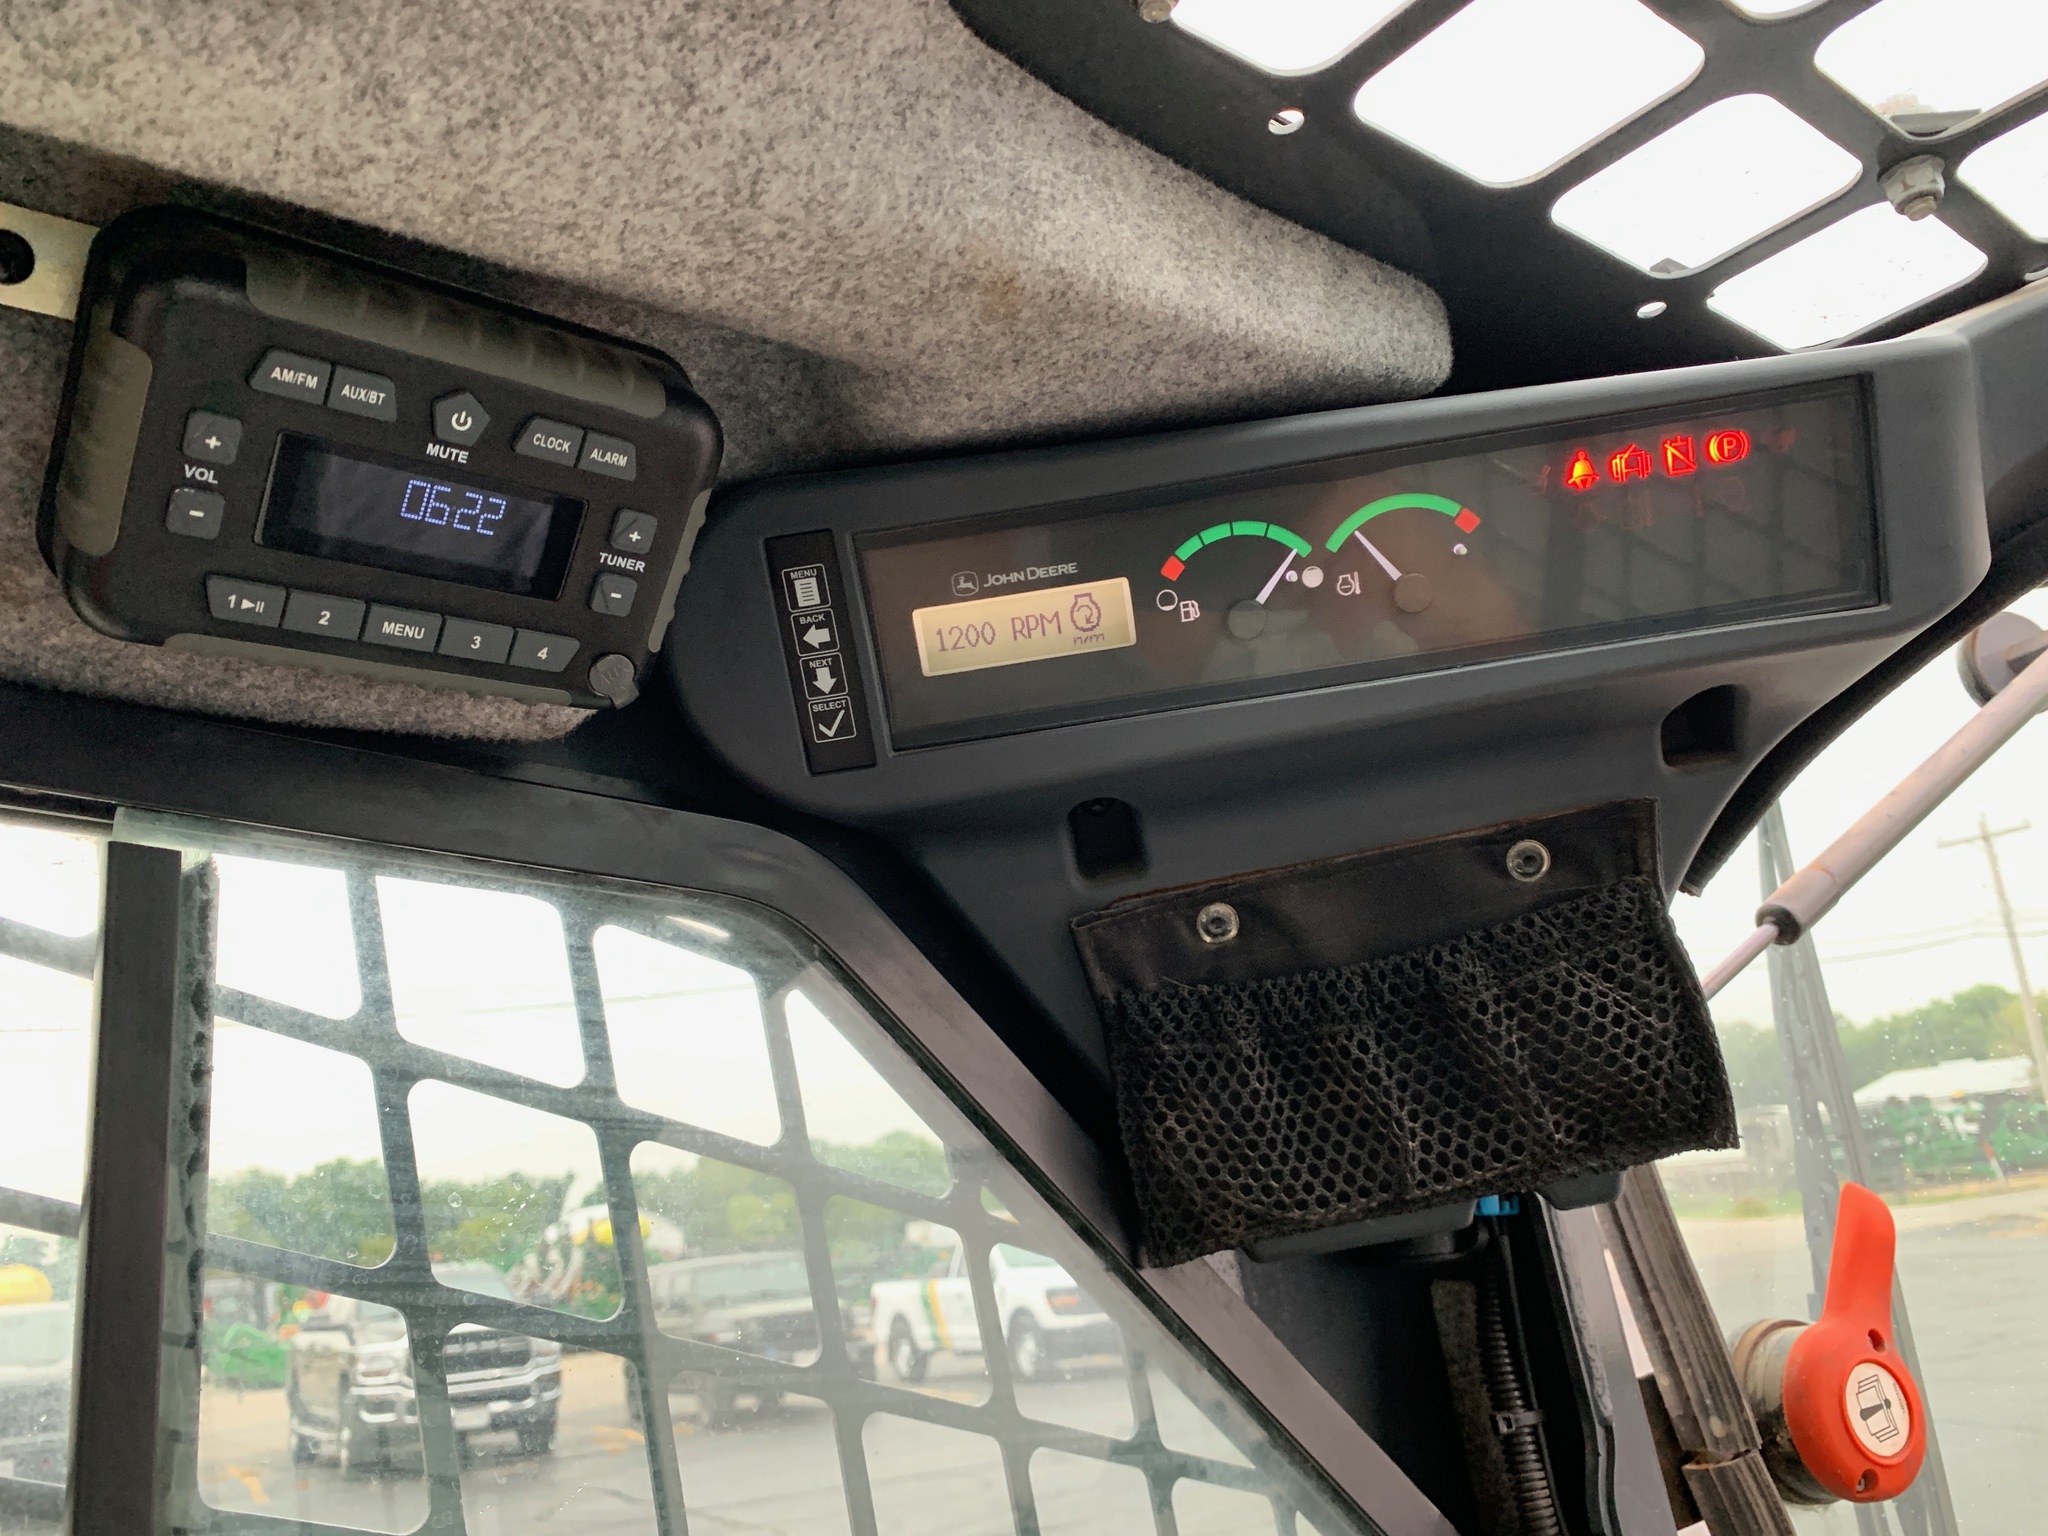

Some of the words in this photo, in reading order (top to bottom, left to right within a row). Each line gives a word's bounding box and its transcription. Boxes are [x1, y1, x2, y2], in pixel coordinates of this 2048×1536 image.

[271, 366, 318, 390] AM/FM
[341, 383, 386, 406] AUX/BT
[426, 442, 469, 464] MUTE
[533, 433, 572, 453] CLOCK
[589, 447, 628, 467] ALARM
[183, 464, 219, 484] VOL
[599, 552, 646, 573] TUNER
[790, 569, 817, 579] MENU
[983, 571, 1024, 588] JOHN
[1026, 562, 1078, 580] DEERE
[226, 592, 237, 609] 1
[318, 610, 331, 627] 2
[799, 613, 825, 625] BACK
[381, 620, 425, 640] MENU
[936, 621, 996, 652] 1200
[1011, 611, 1063, 641] RPM
[470, 634, 482, 650] 3
[536, 646, 549, 661] 4
[809, 658, 833, 668] NEXT
[812, 701, 846, 712] SELECT
